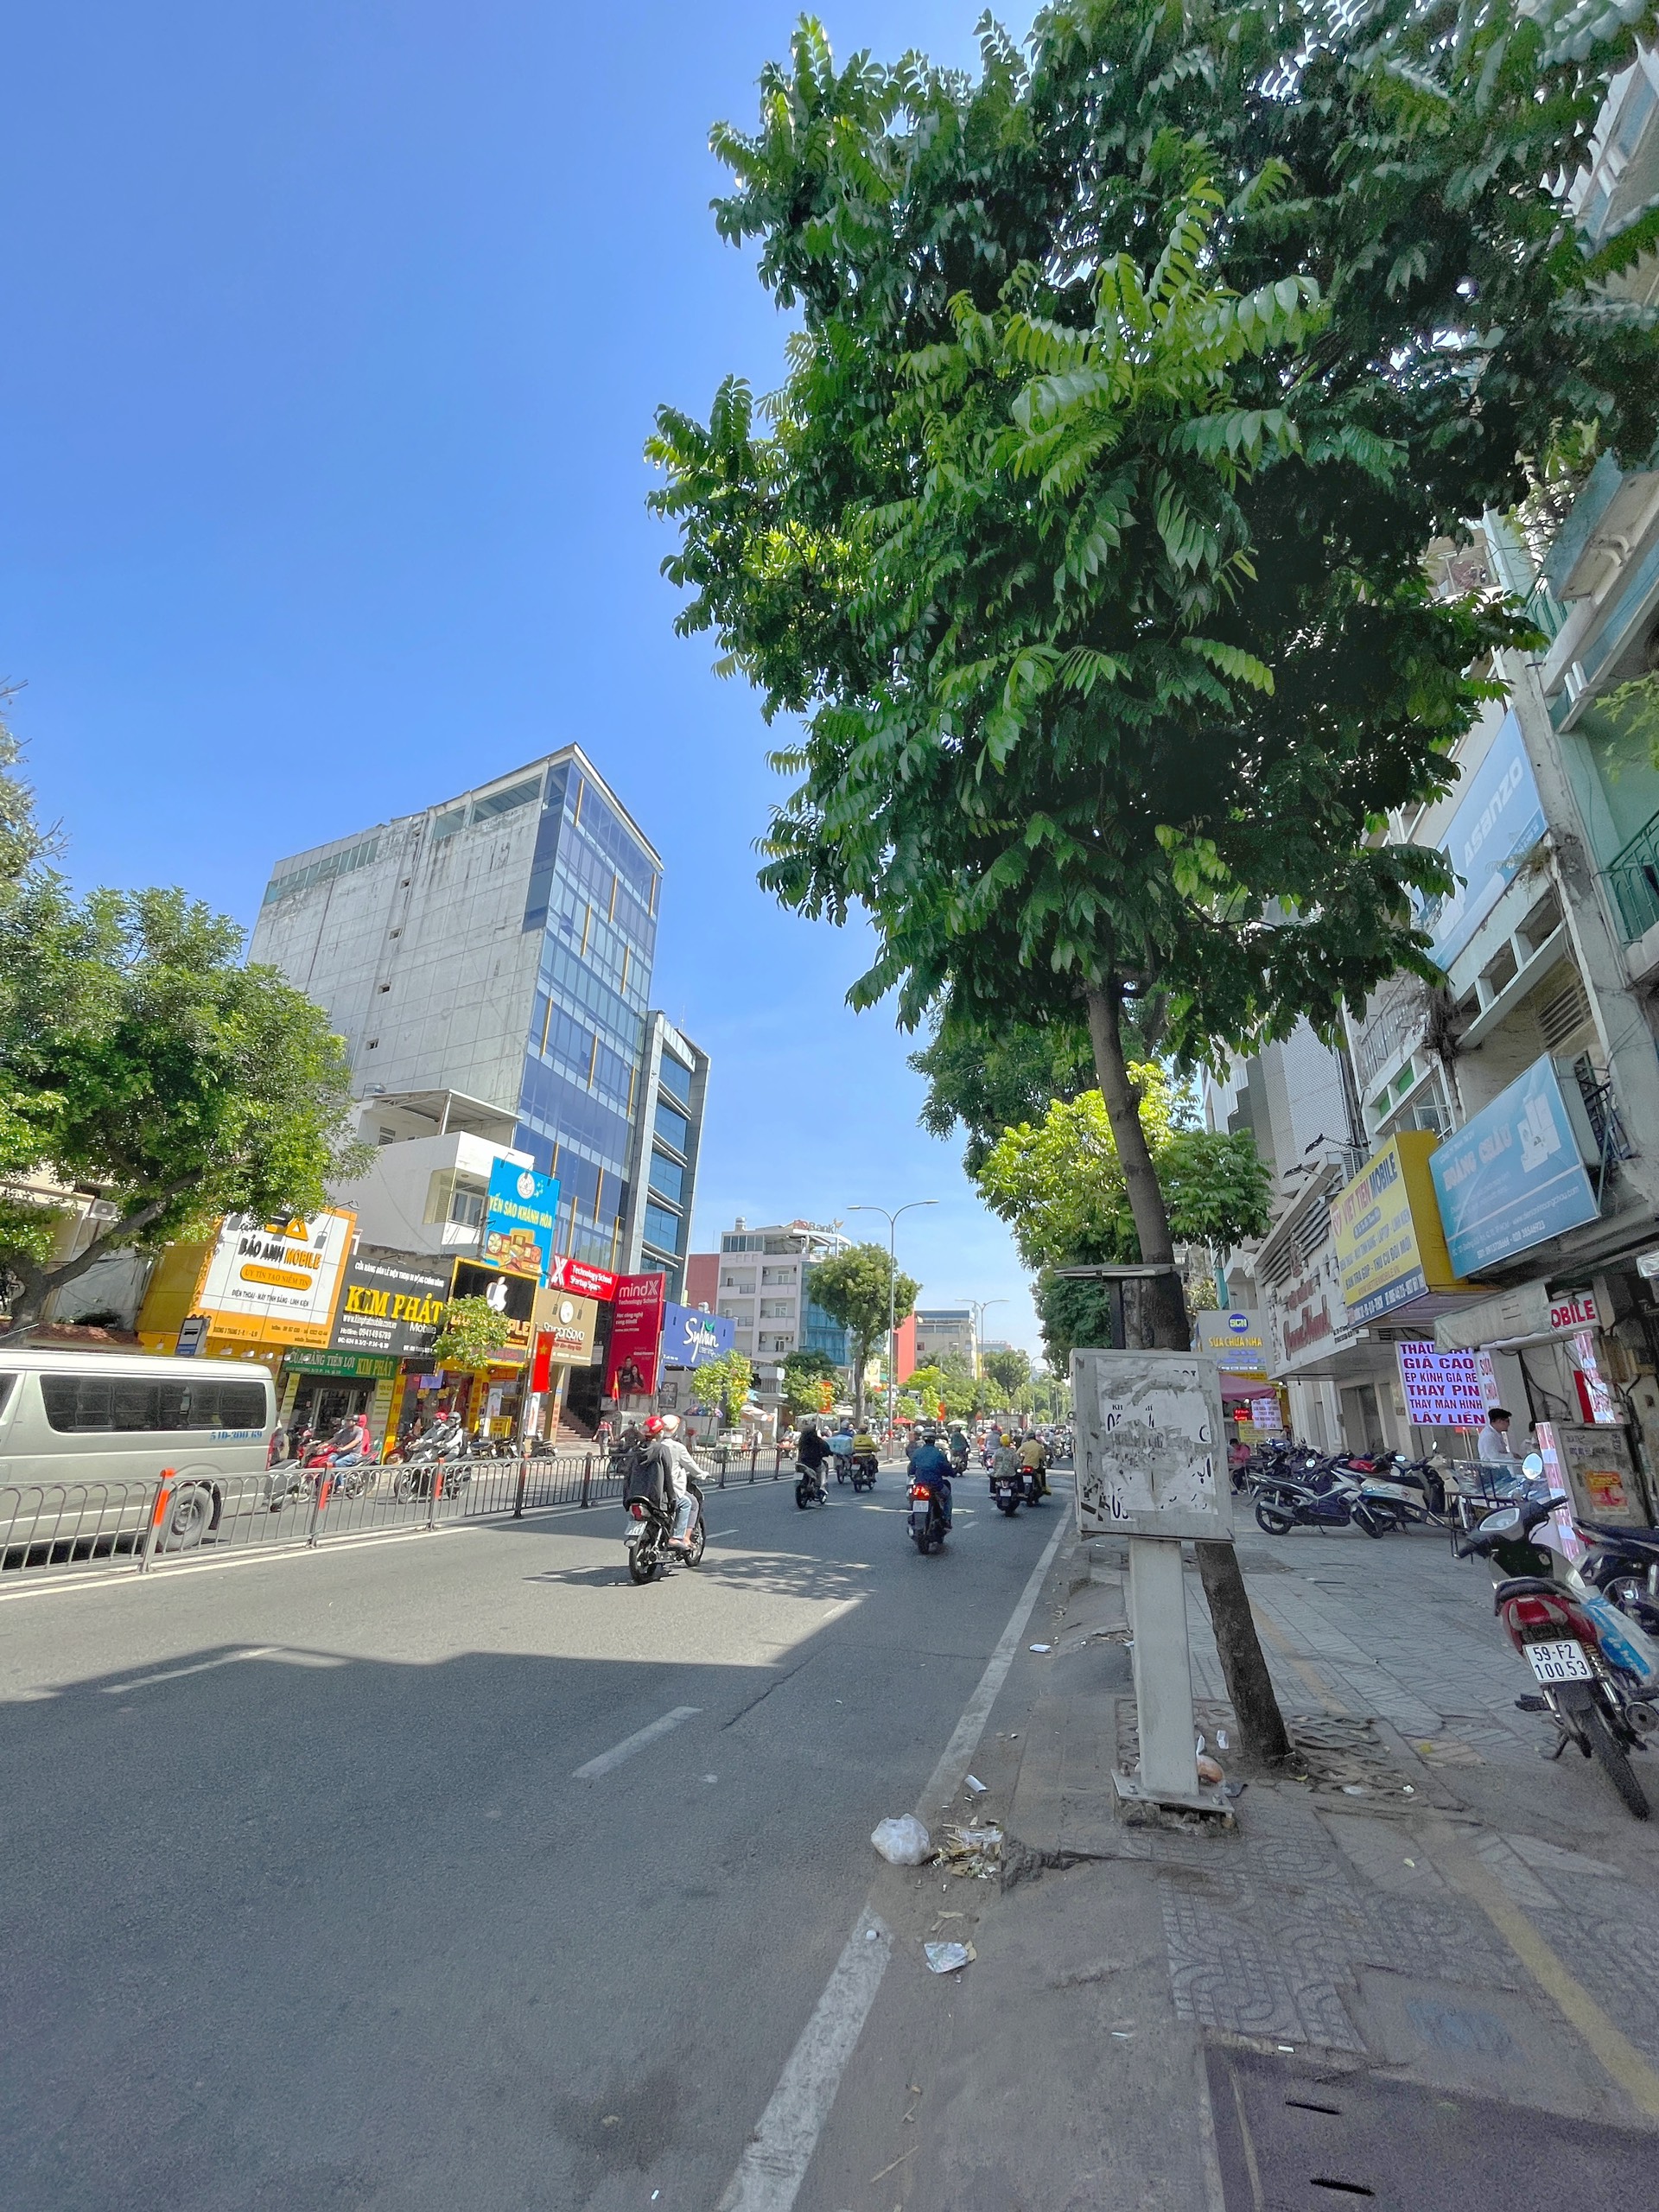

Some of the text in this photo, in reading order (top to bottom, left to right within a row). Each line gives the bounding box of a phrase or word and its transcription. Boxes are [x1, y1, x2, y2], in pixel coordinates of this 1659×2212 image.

[1464, 756, 1523, 868] Asanzo
[1369, 1151, 1398, 1199] MOBILE
[489, 1192, 502, 1212] YẾN
[505, 1198, 517, 1218] SÀO
[518, 1205, 539, 1226] KHÁNH
[238, 1234, 322, 1269] BẢO ANH MOBILE
[570, 1275, 588, 1289] Startup
[572, 1265, 612, 1285] Technology School
[619, 1280, 658, 1298] mindX
[345, 1286, 391, 1318] KIM
[391, 1292, 443, 1324] PHÁT
[410, 1322, 438, 1334] Mobile
[683, 1318, 719, 1363] Sylvan
[356, 1358, 372, 1375] KIM
[372, 1356, 394, 1376] PHÁT
[1404, 1351, 1474, 1369] GIÁ CAO
[1420, 1370, 1443, 1382] KÍNH
[1446, 1370, 1465, 1382] GIÁ
[1408, 1384, 1480, 1396] THAY PIN
[1409, 1396, 1483, 1409] THAY MÀN HÌNH
[1413, 1409, 1486, 1424] LẤY LIỀN
[1534, 1643, 1576, 1662] 59-F2
[1535, 1659, 1588, 1681] 100.53
